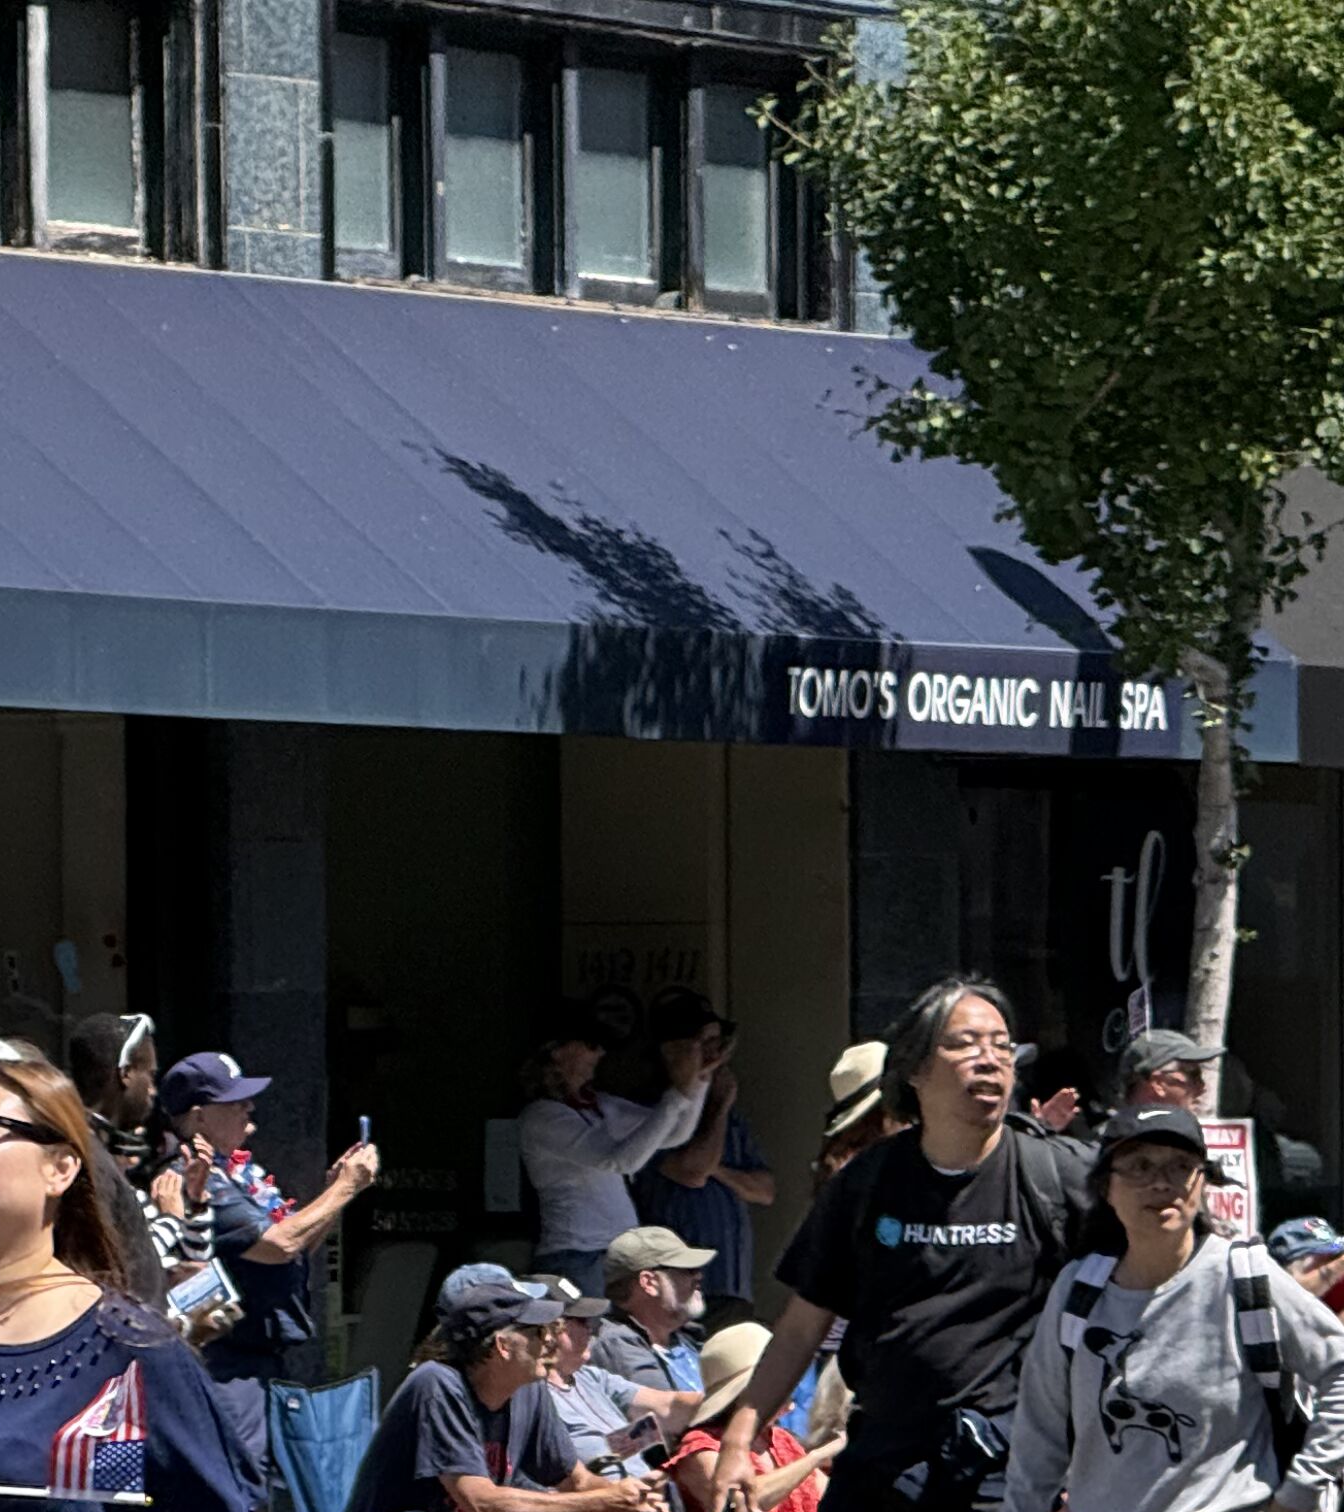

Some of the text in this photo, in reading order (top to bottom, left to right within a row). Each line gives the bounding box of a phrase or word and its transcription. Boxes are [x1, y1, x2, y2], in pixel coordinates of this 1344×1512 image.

[787, 667, 1169, 731] TOMO'S ORGANIC NAIL SPA
[903, 1223, 1017, 1246] HUNTRESS
